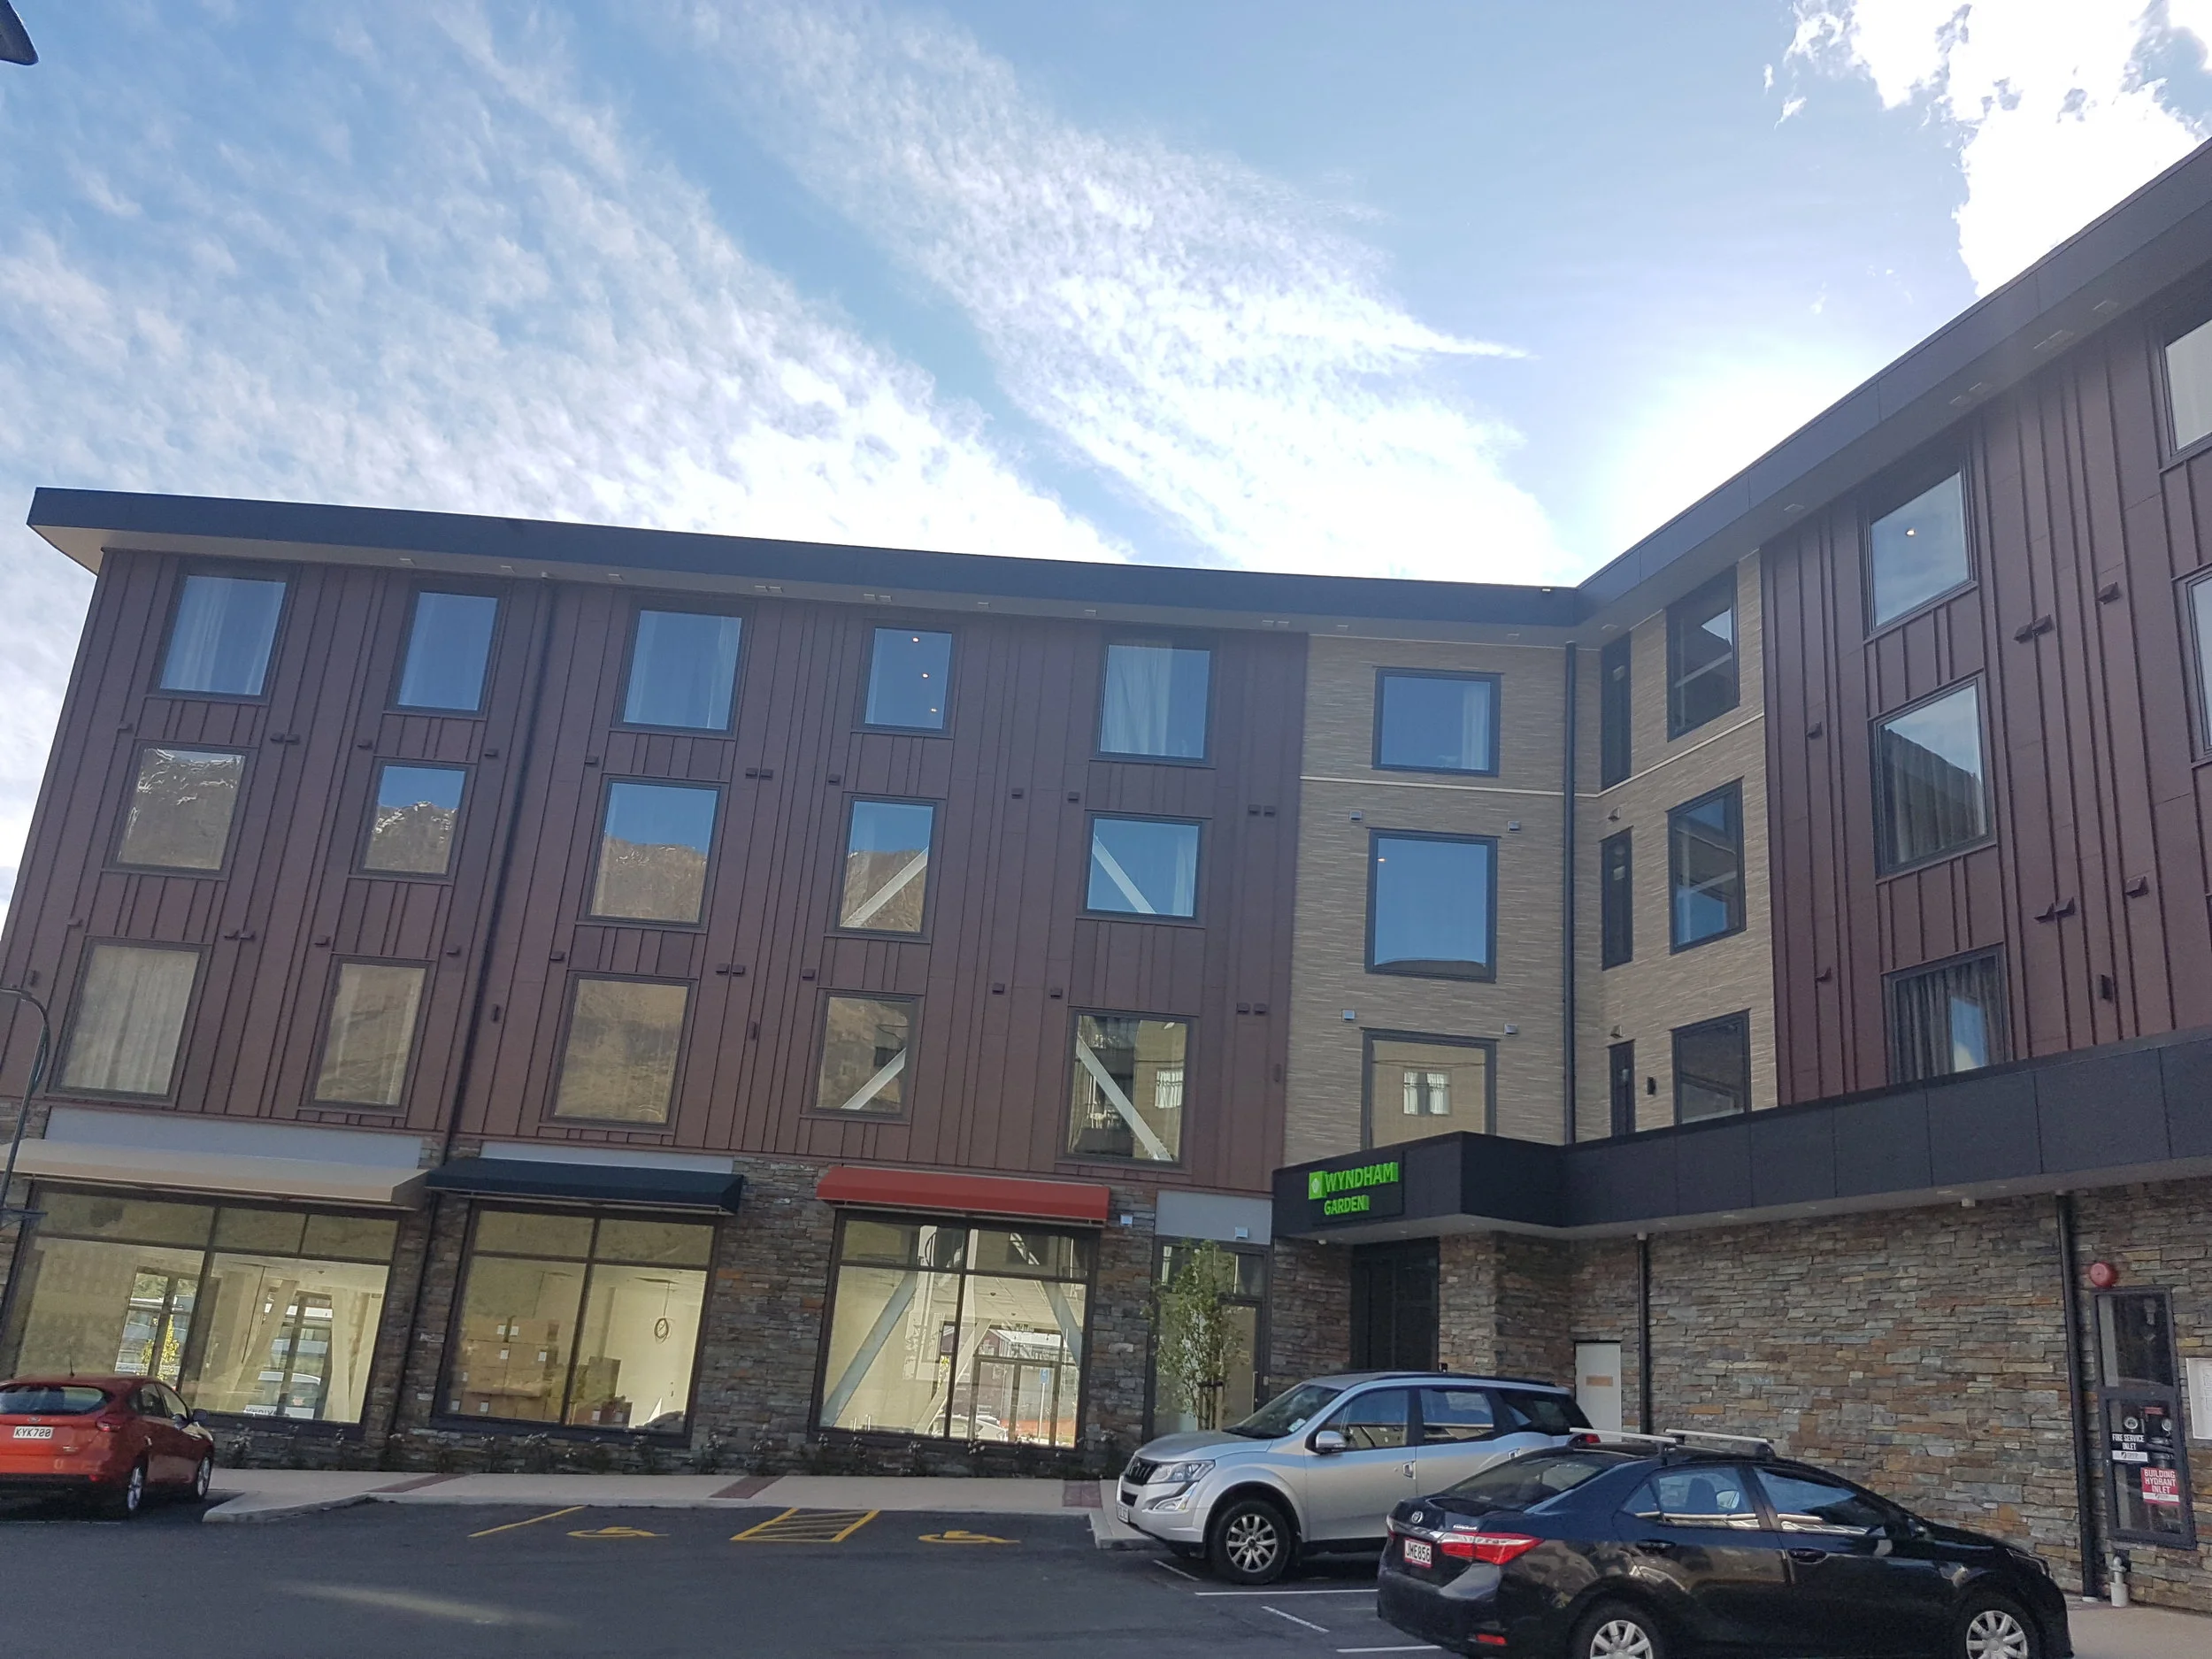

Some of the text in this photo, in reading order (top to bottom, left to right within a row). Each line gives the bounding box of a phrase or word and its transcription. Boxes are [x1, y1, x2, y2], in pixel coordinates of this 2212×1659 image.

[1325, 1162, 1398, 1192] WYNDHAM
[1325, 1194, 1370, 1215] GARDEN
[2144, 1469, 2176, 1479] BUILDING
[2145, 1478, 2176, 1486] HYDRANT
